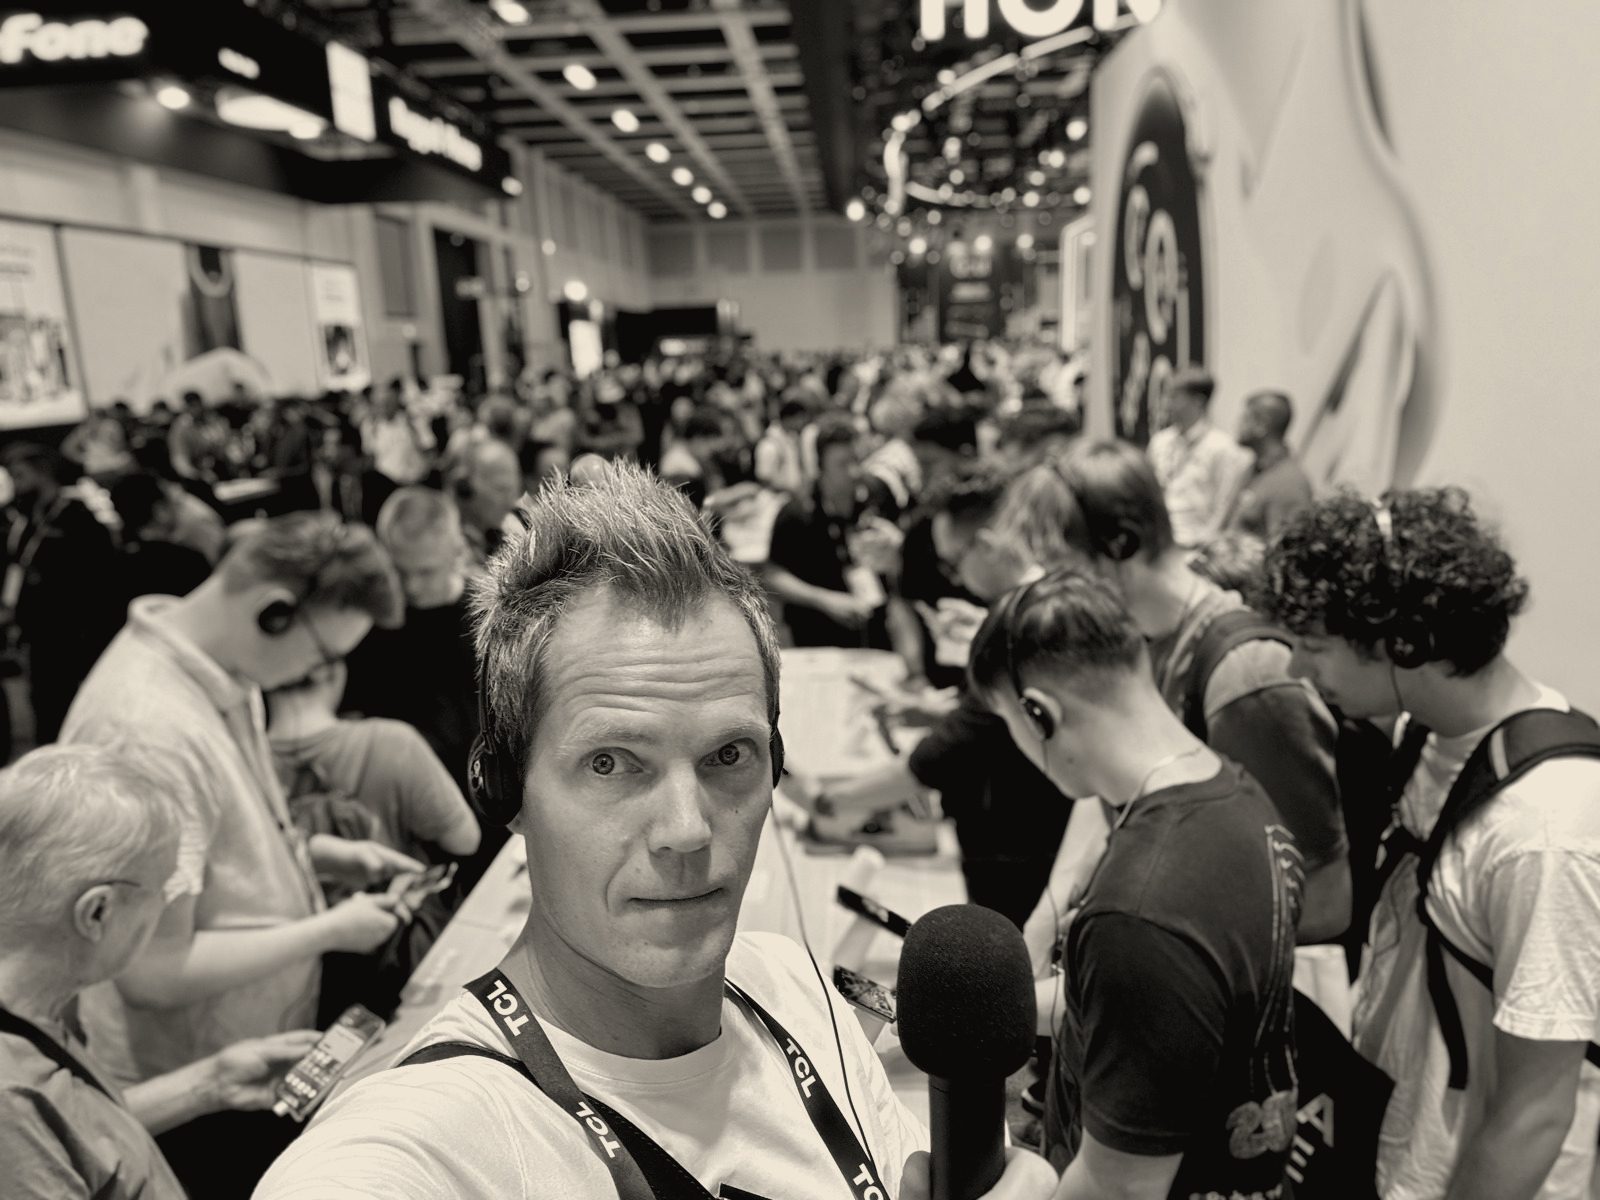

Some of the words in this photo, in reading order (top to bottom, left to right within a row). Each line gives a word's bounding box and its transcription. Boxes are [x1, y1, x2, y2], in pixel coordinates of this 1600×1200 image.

[486, 979, 530, 1037] TCL
[785, 1038, 817, 1099] TCL
[575, 1101, 622, 1158] TCL
